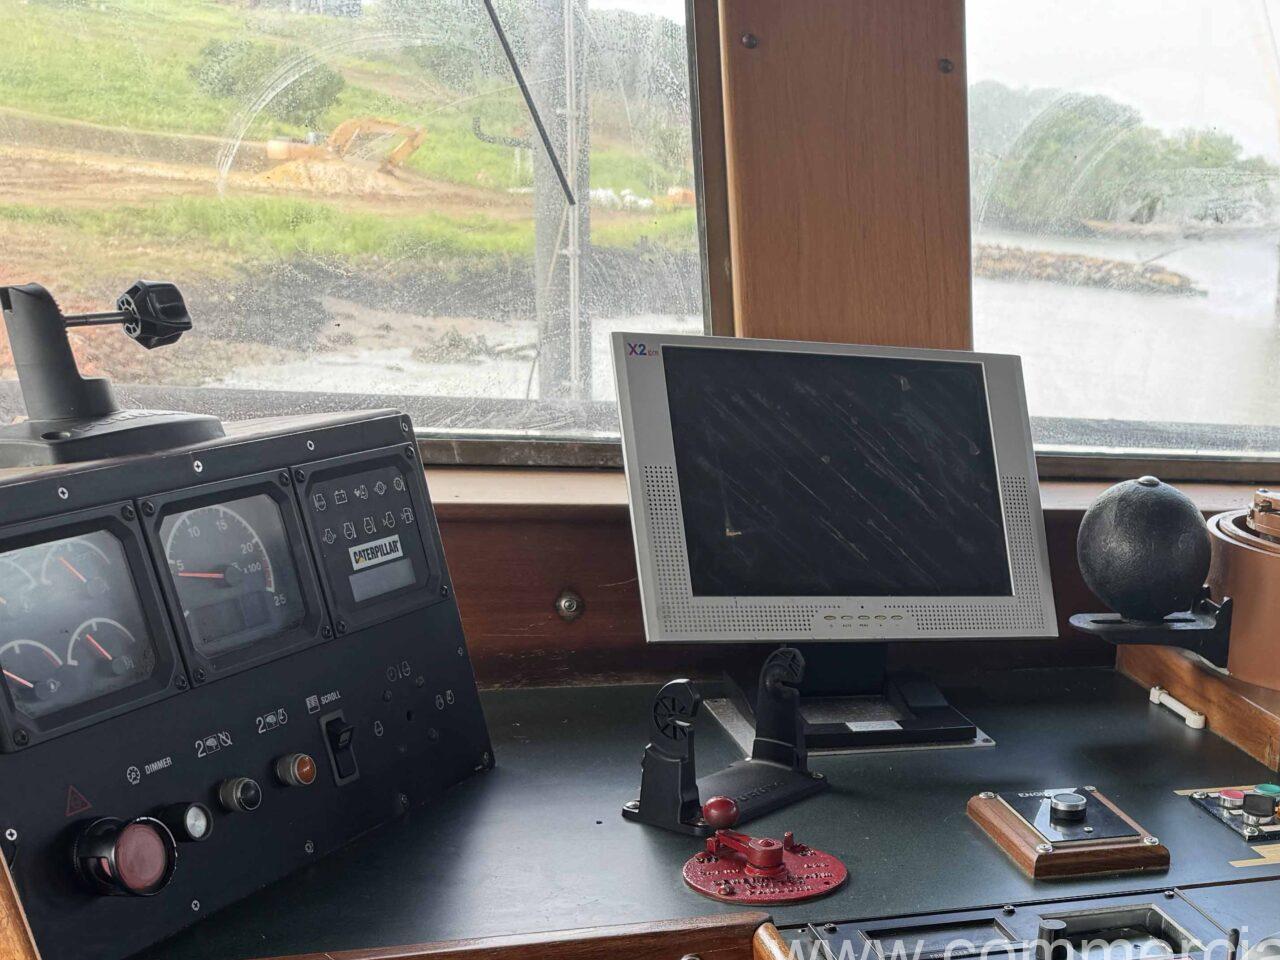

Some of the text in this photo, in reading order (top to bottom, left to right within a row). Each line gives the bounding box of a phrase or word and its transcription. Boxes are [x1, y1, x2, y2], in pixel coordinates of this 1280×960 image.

[626, 342, 647, 356] X2
[187, 525, 201, 538] 10
[216, 520, 228, 531] 15
[241, 542, 254, 554] 20
[353, 540, 401, 564] CATERPILLAR
[176, 559, 185, 571] 5
[273, 593, 287, 606] 25
[320, 690, 342, 706] SCROLL
[144, 756, 173, 776] DIMMER
